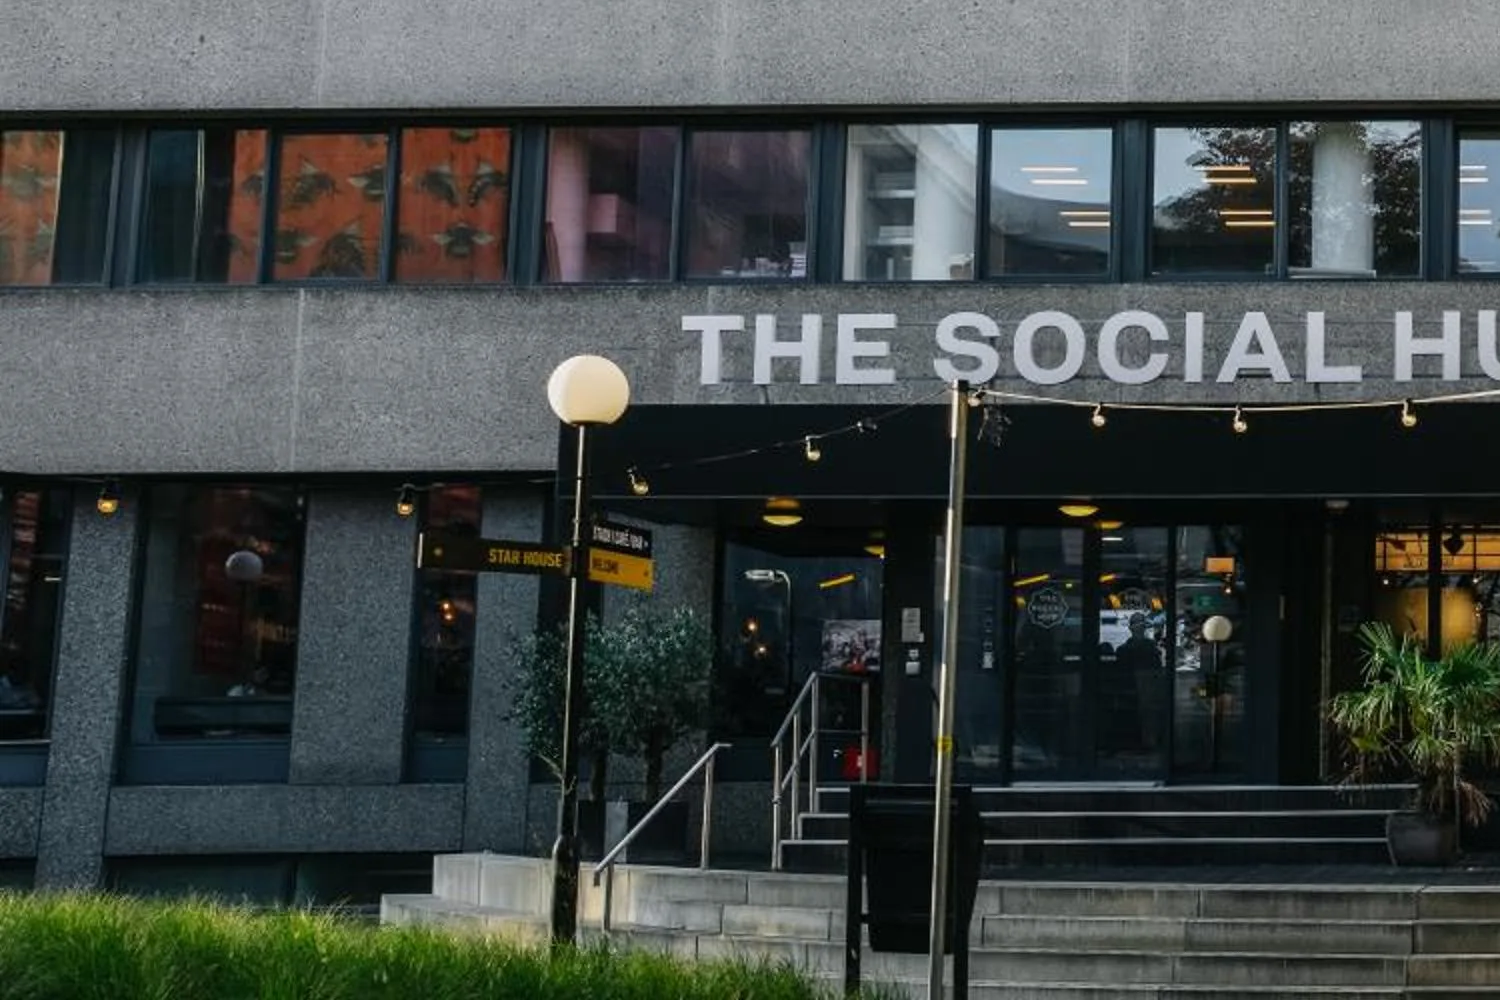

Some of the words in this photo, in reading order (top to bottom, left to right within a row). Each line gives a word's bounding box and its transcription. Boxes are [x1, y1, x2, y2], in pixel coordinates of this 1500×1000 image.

[681, 313, 897, 386] THE
[933, 310, 1362, 385] SOCIAL
[489, 547, 520, 565] STAR
[523, 551, 564, 568] HOUSE
